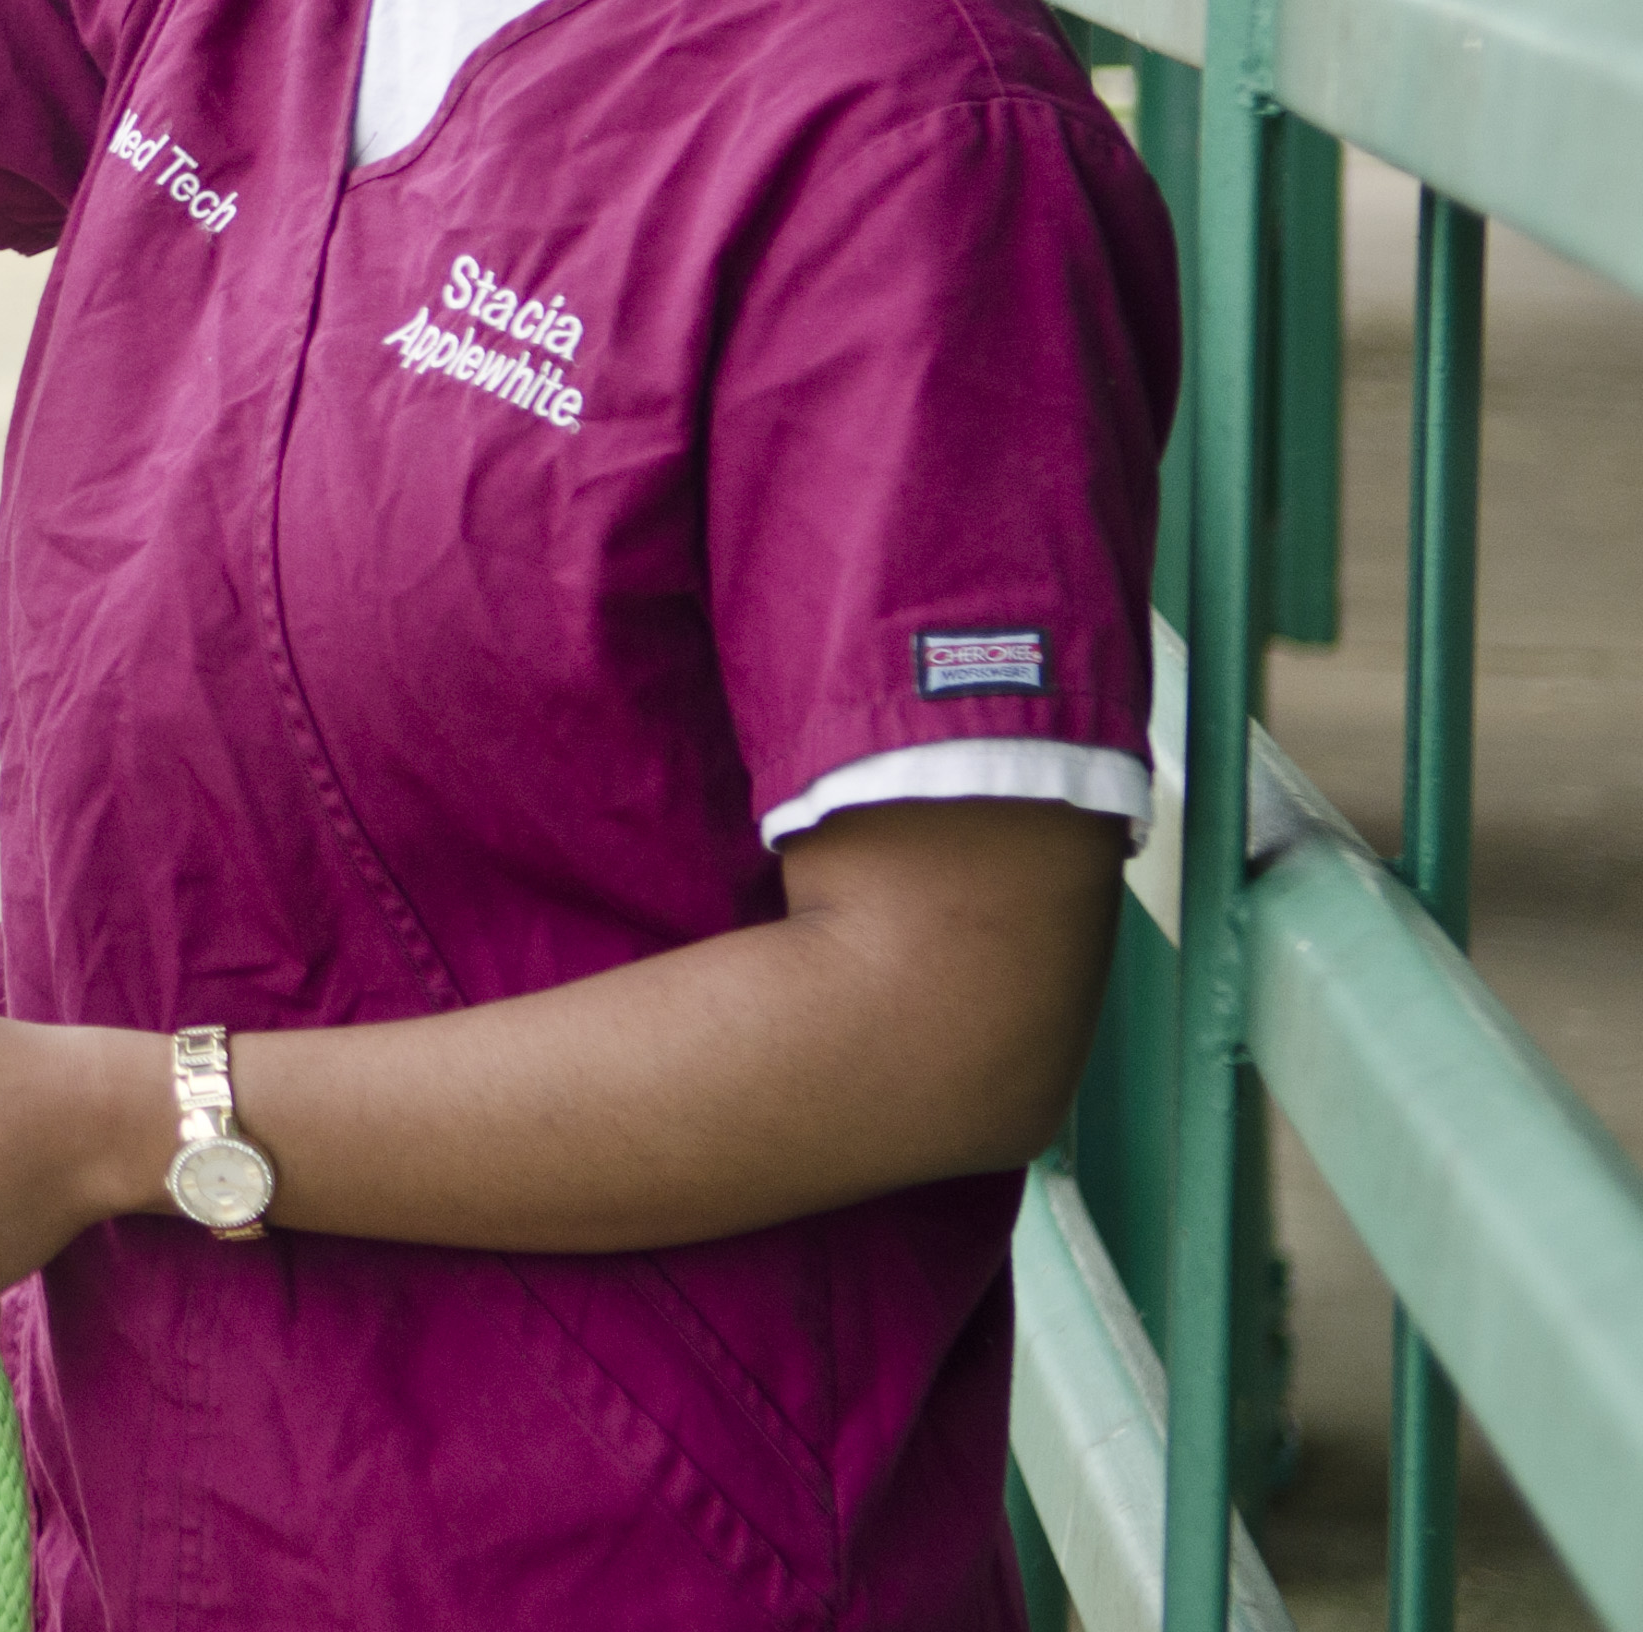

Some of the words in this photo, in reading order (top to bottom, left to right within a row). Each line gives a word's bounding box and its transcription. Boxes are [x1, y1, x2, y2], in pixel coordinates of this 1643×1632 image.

[156, 145, 239, 233] Tech
[442, 254, 584, 362] Stacia
[382, 306, 584, 428] Applewhite
[927, 646, 1034, 664] CHEROKEE
